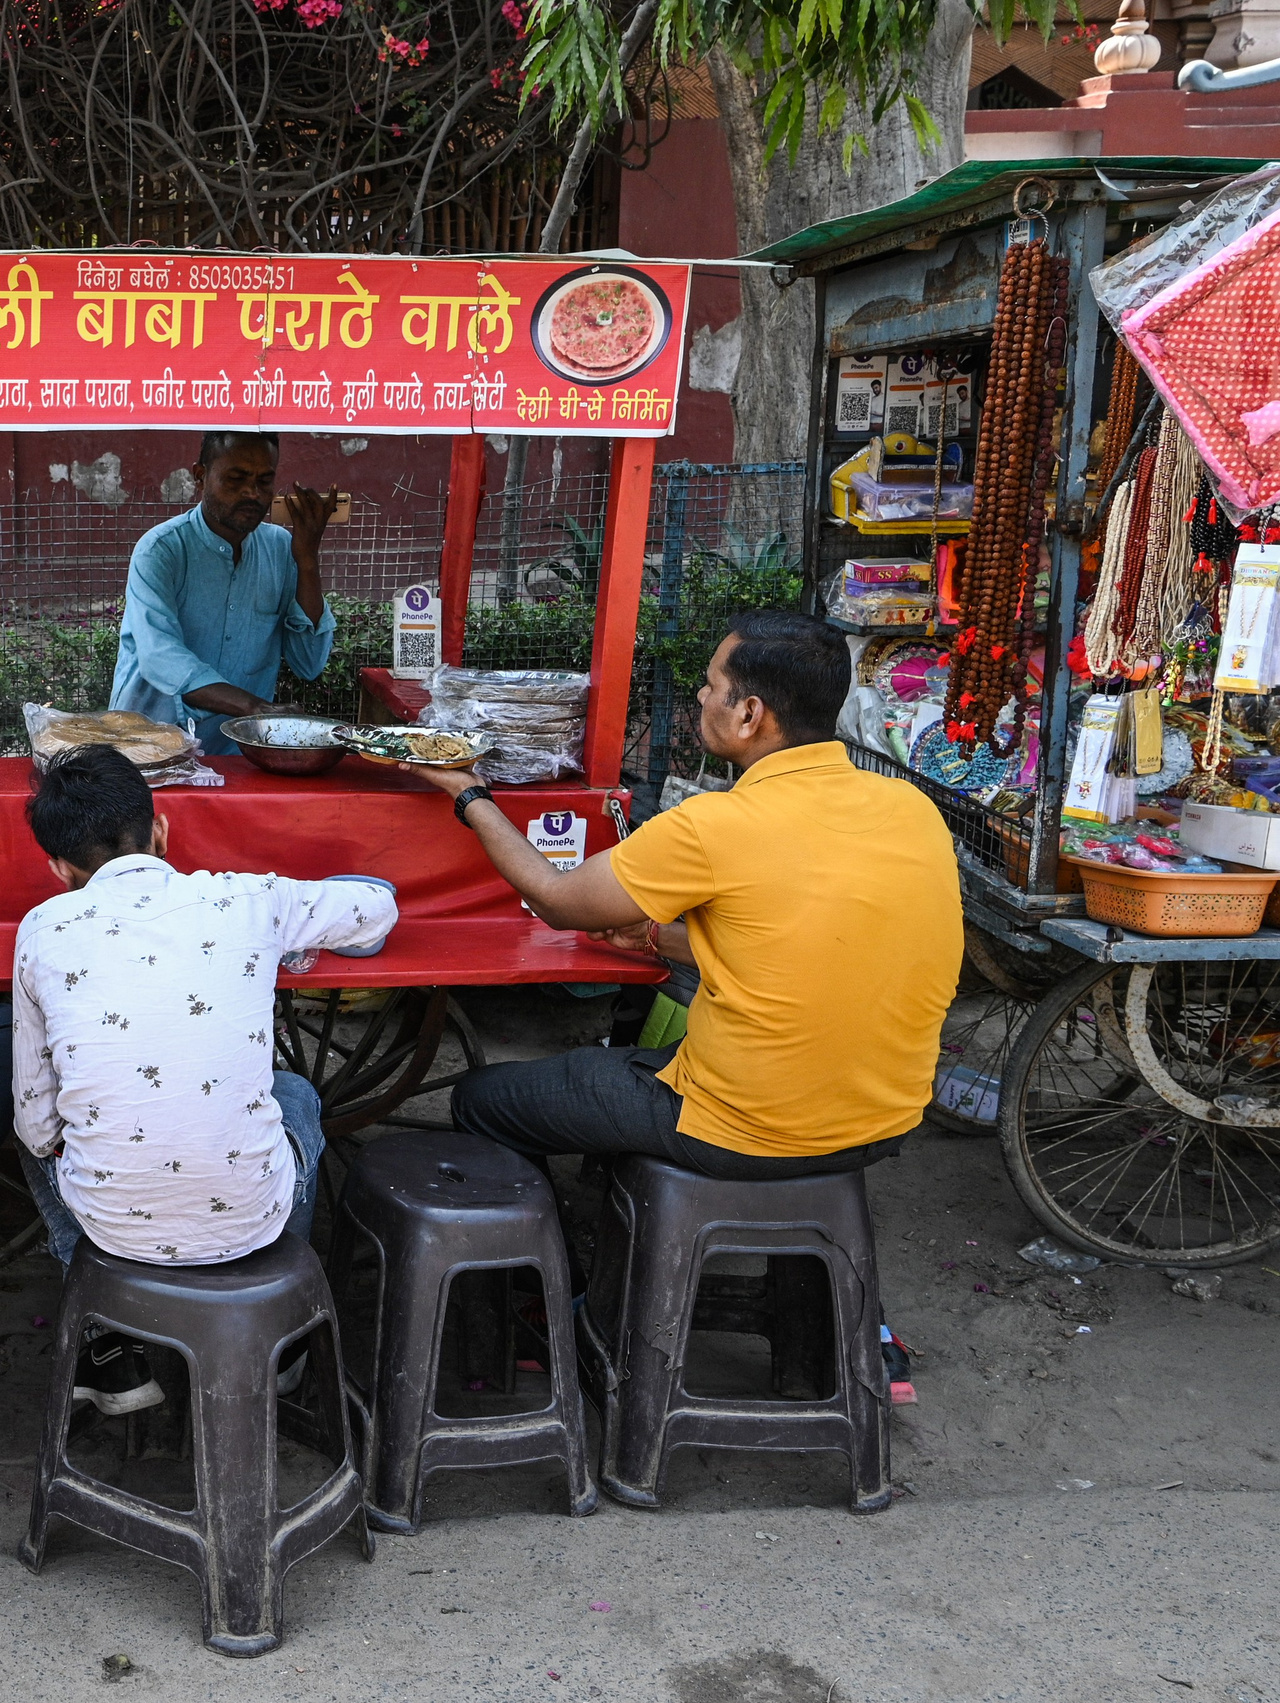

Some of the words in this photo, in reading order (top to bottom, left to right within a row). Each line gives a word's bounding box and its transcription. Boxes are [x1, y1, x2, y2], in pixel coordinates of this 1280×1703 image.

[76, 259, 124, 291] दिनेश
[129, 261, 171, 289] बघेल
[189, 264, 295, 291] 8503035451
[73, 290, 218, 350] बाबा
[236, 271, 380, 352] पराठे
[399, 273, 521, 354] वाले
[39, 379, 80, 408] सादा
[84, 378, 135, 413] पराठा,
[141, 366, 186, 409] पनीर
[191, 369, 235, 414] पराठे,
[291, 370, 335, 414] पराठे,
[342, 368, 379, 421] मूली
[383, 372, 426, 415] पराठे,
[433, 381, 467, 411] तवा
[515, 386, 554, 423] देशी
[558, 387, 581, 420] घी
[586, 388, 606, 421] से
[611, 388, 672, 422] निर्मित
[401, 612, 433, 620] PhonePe
[536, 837, 575, 847] PhonePe
